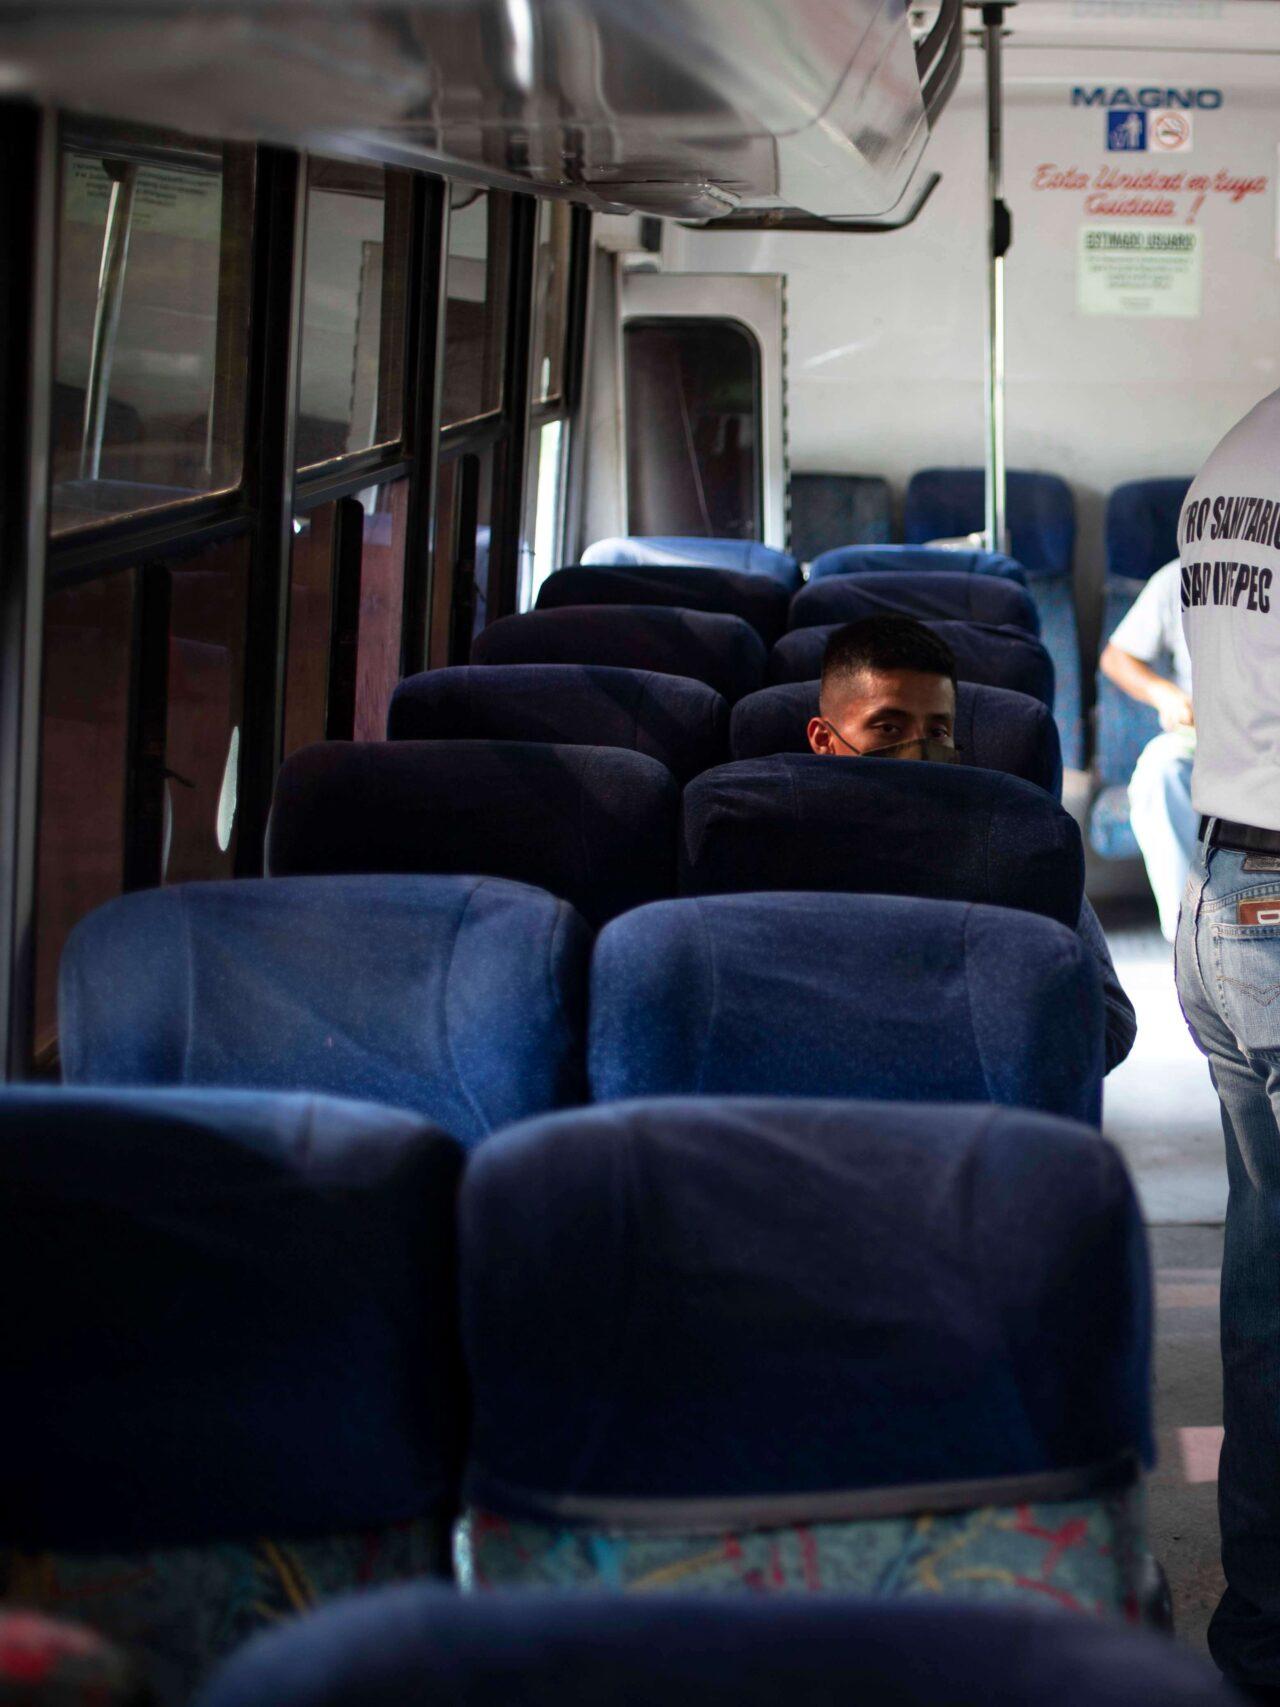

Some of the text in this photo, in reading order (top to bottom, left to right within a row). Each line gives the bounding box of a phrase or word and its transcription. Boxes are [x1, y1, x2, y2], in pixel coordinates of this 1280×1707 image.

[1071, 86, 1223, 110] MAGNO
[1034, 163, 1089, 191] Esta
[1213, 168, 1268, 203] tuya
